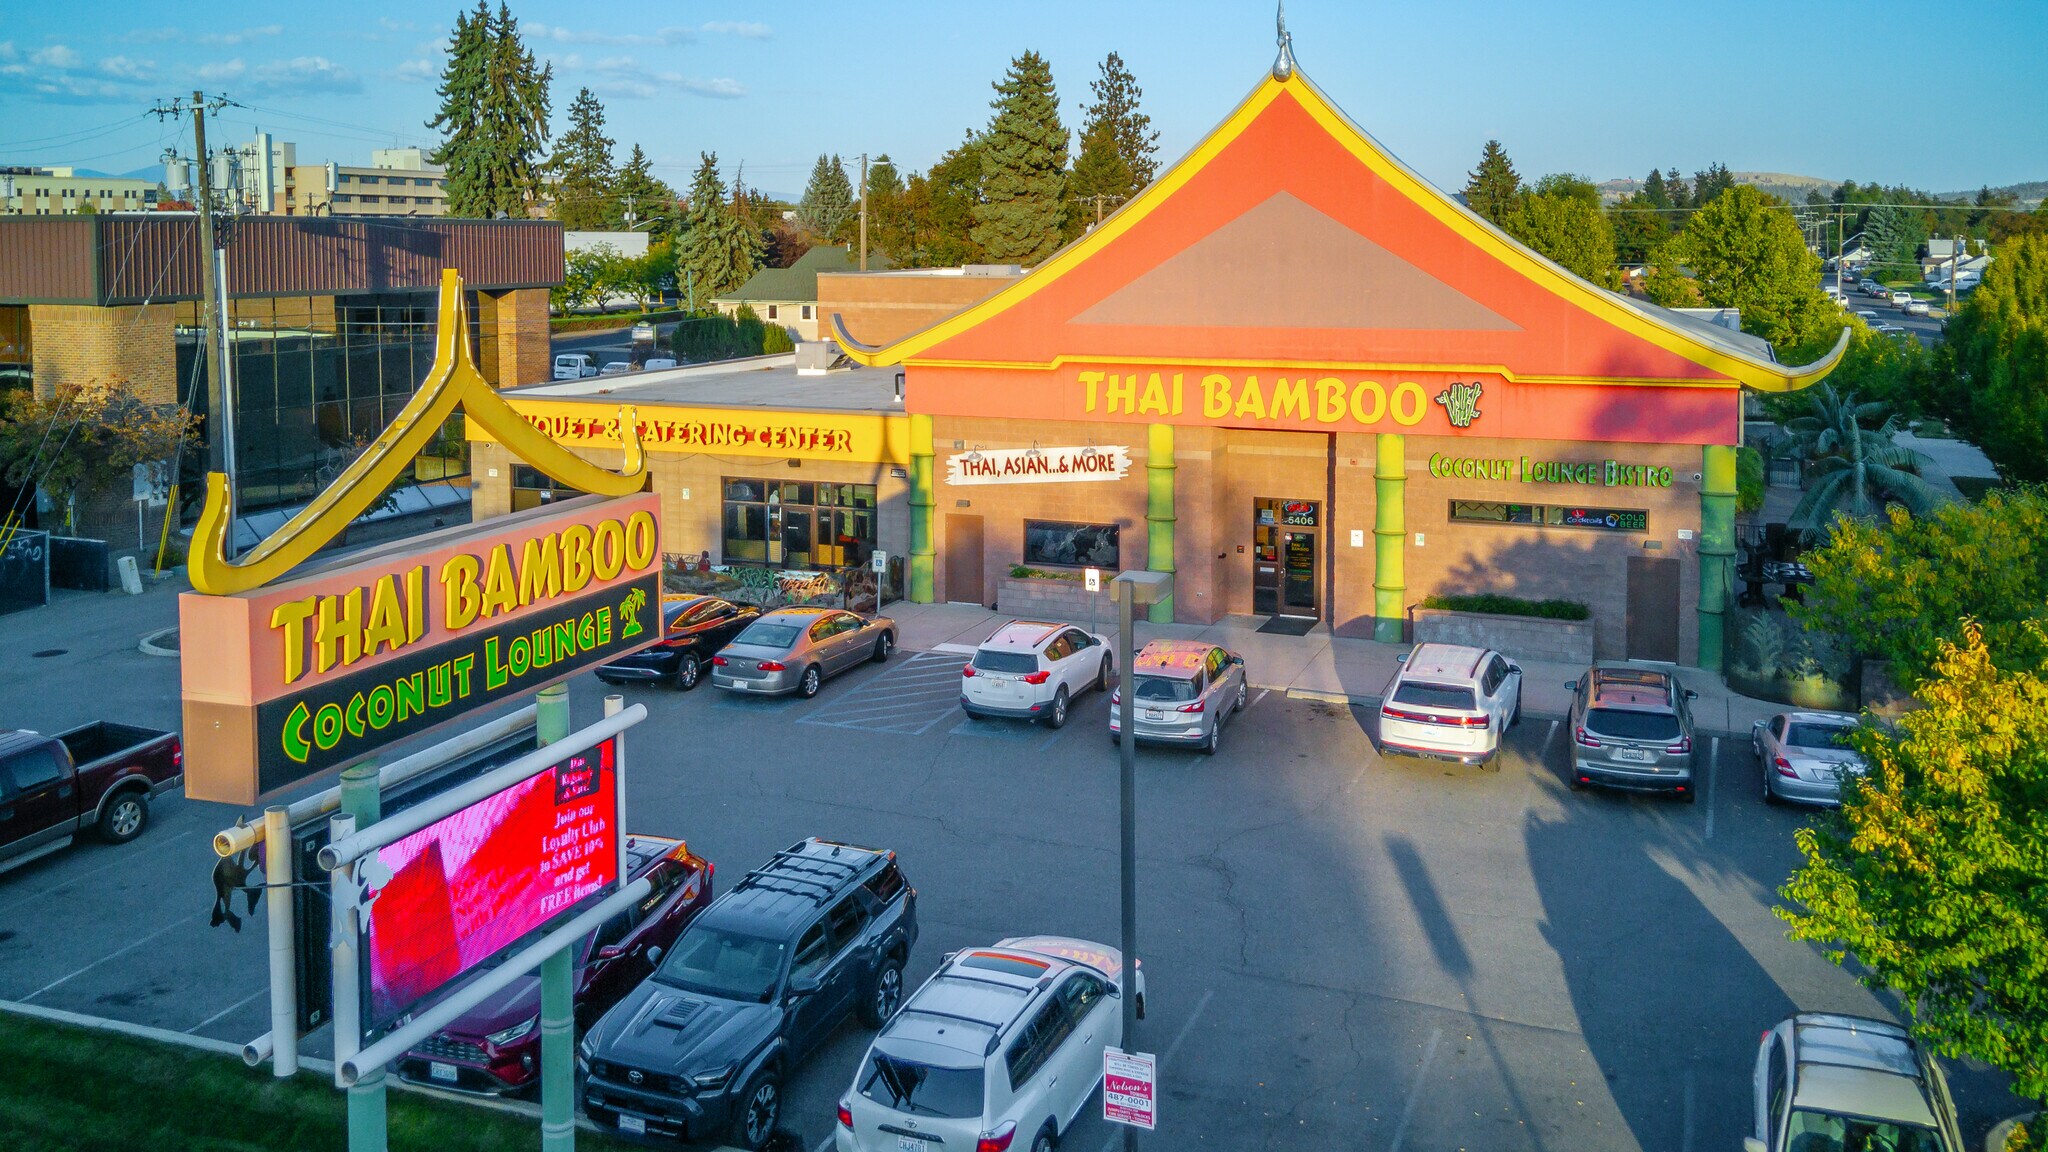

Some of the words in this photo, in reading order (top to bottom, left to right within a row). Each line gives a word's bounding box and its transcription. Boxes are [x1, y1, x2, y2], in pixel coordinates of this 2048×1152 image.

[1077, 371, 1184, 416] THAI
[1200, 373, 1427, 426] BAMBOO
[637, 420, 746, 447] ATERING
[754, 426, 852, 452] CENTER
[960, 457, 1001, 477] THAI,
[1072, 454, 1115, 473] MORE
[1429, 452, 1514, 481] COCONUT
[1520, 455, 1597, 485] LOUNGE
[1604, 459, 1674, 488] BISTRO
[1288, 516, 1314, 525] 5406
[270, 564, 424, 685] THAI
[440, 510, 657, 630] BAMBOO
[281, 653, 475, 763] COCONUT
[485, 606, 612, 691] LOUNGE
[554, 809, 576, 829] Join
[579, 805, 594, 817] our
[542, 827, 580, 853] Loyalty
[582, 817, 605, 837] Club
[540, 860, 550, 873] to
[552, 845, 581, 869] SAVE
[554, 866, 574, 887] and
[576, 861, 590, 882] get
[540, 886, 572, 914] FREE
[1106, 1080, 1148, 1090] Nelson's
[1108, 1092, 1148, 1107] 487-0001
